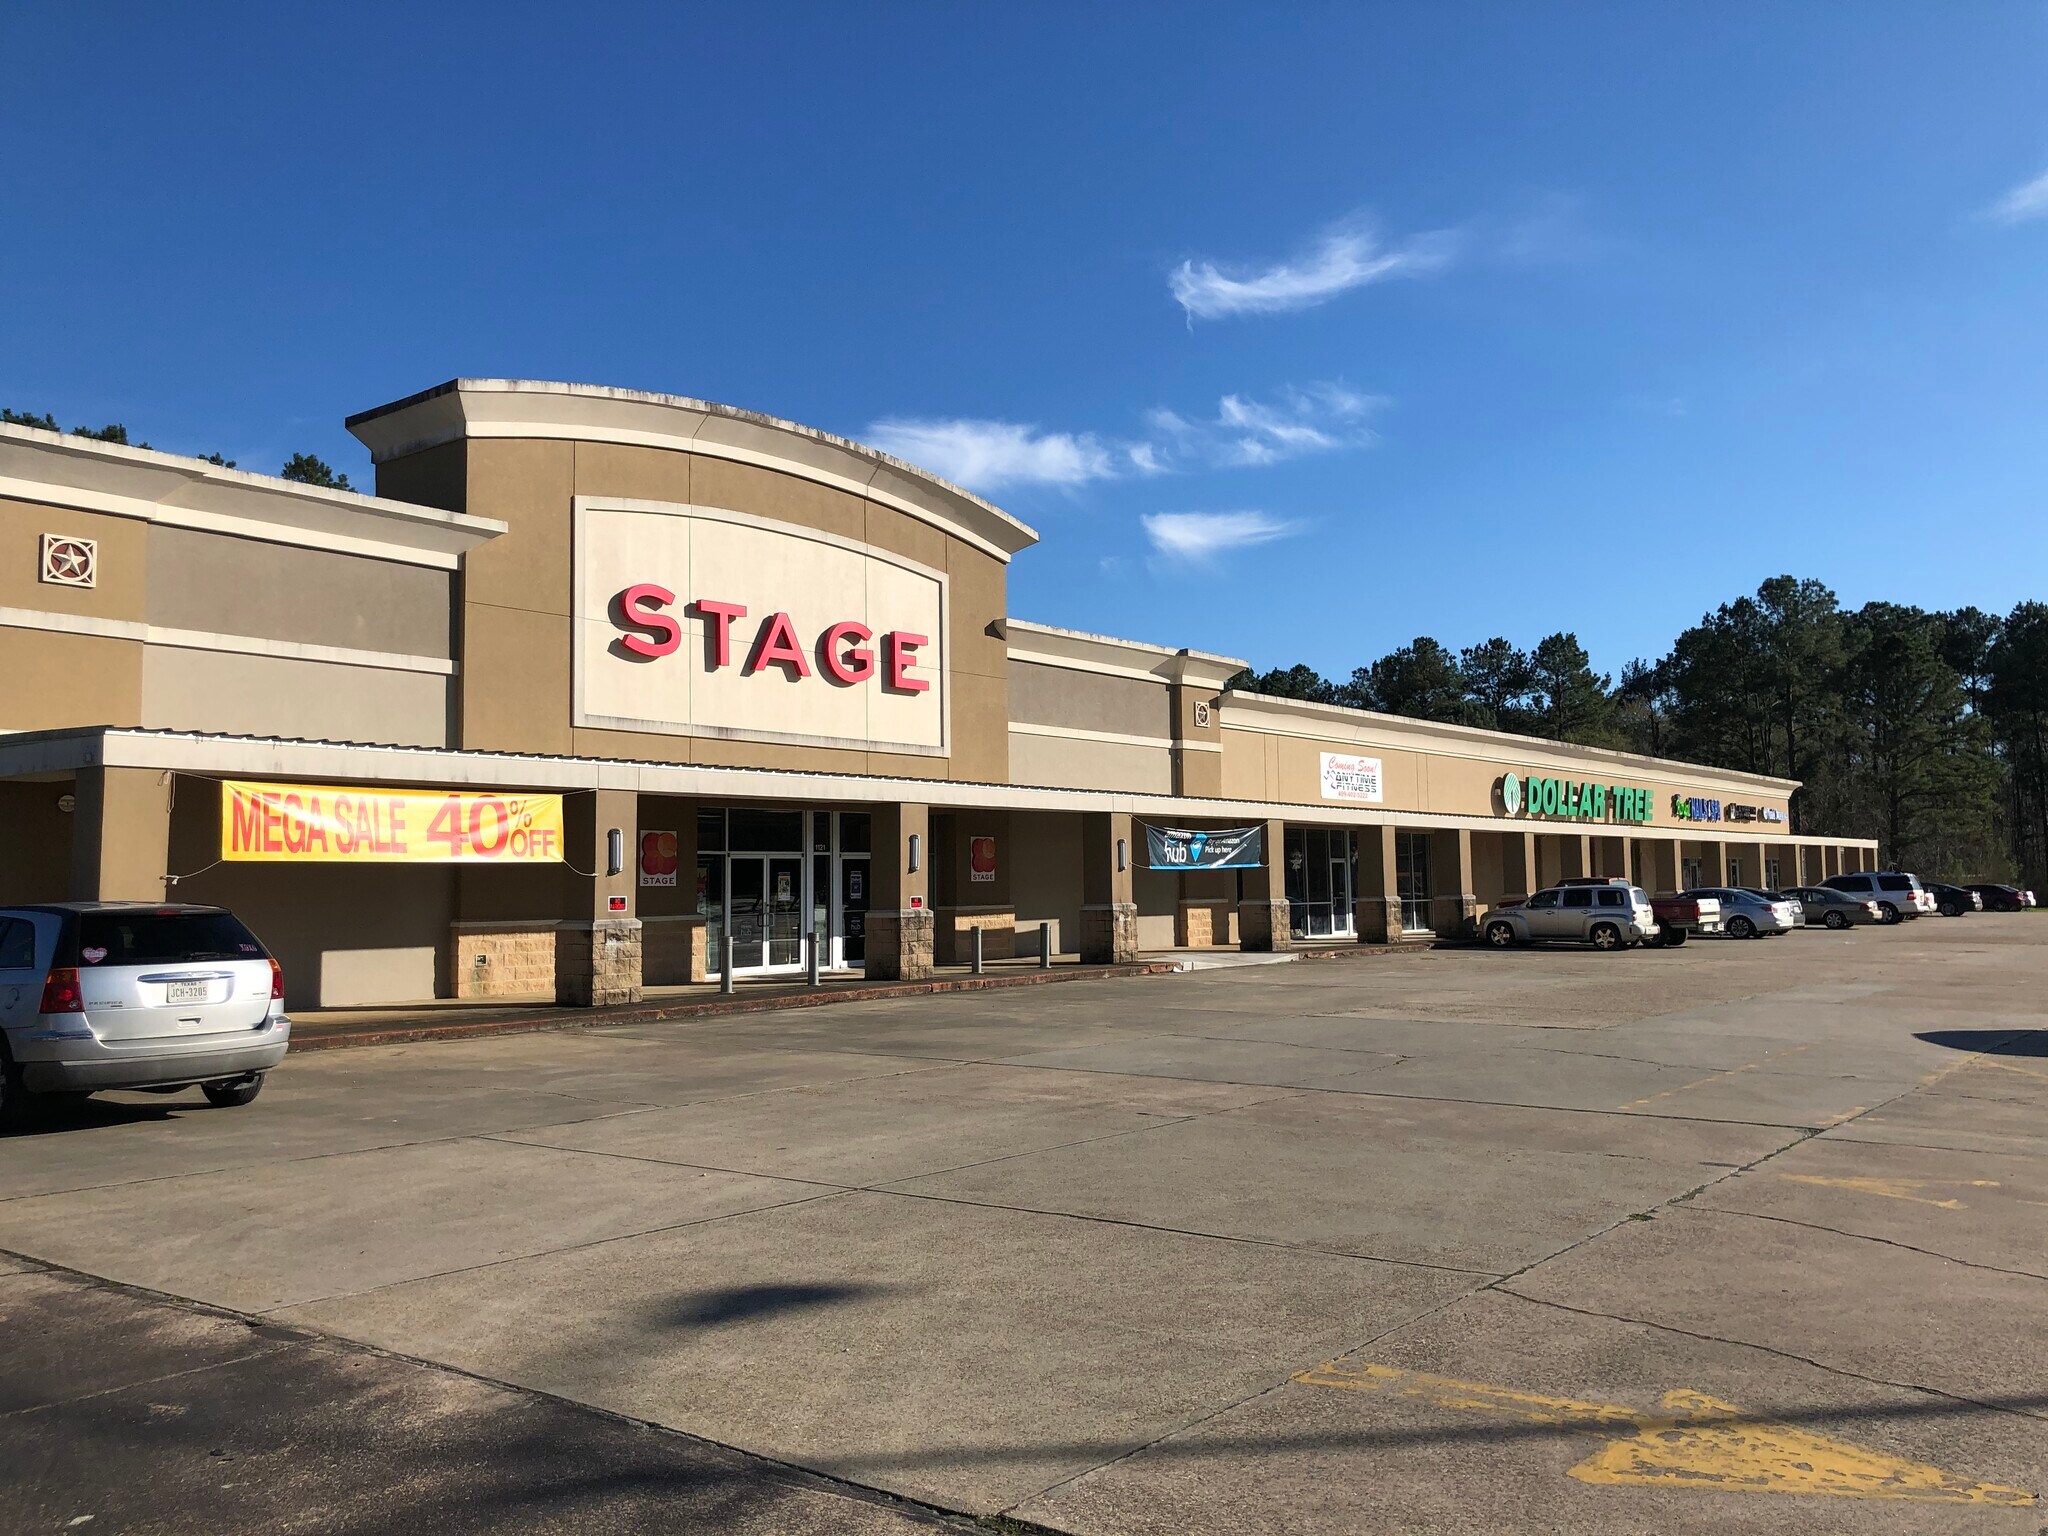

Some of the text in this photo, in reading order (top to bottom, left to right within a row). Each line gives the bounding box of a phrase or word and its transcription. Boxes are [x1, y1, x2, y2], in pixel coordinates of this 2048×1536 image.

[620, 583, 930, 691] STAGE
[1328, 756, 1355, 774] Coming
[1335, 772, 1377, 785] ANYTIME
[1336, 782, 1377, 793] FITNESS
[1526, 776, 1606, 818] DOLLAR
[1611, 785, 1654, 821] TREE
[232, 790, 328, 854] MEGA
[334, 794, 408, 854] SALE
[510, 828, 556, 858] OFF
[1164, 831, 1192, 840] amazon
[1164, 841, 1187, 863] hub
[1204, 845, 1215, 853] Pick
[1215, 847, 1222, 855] up
[642, 877, 675, 885] STAGE
